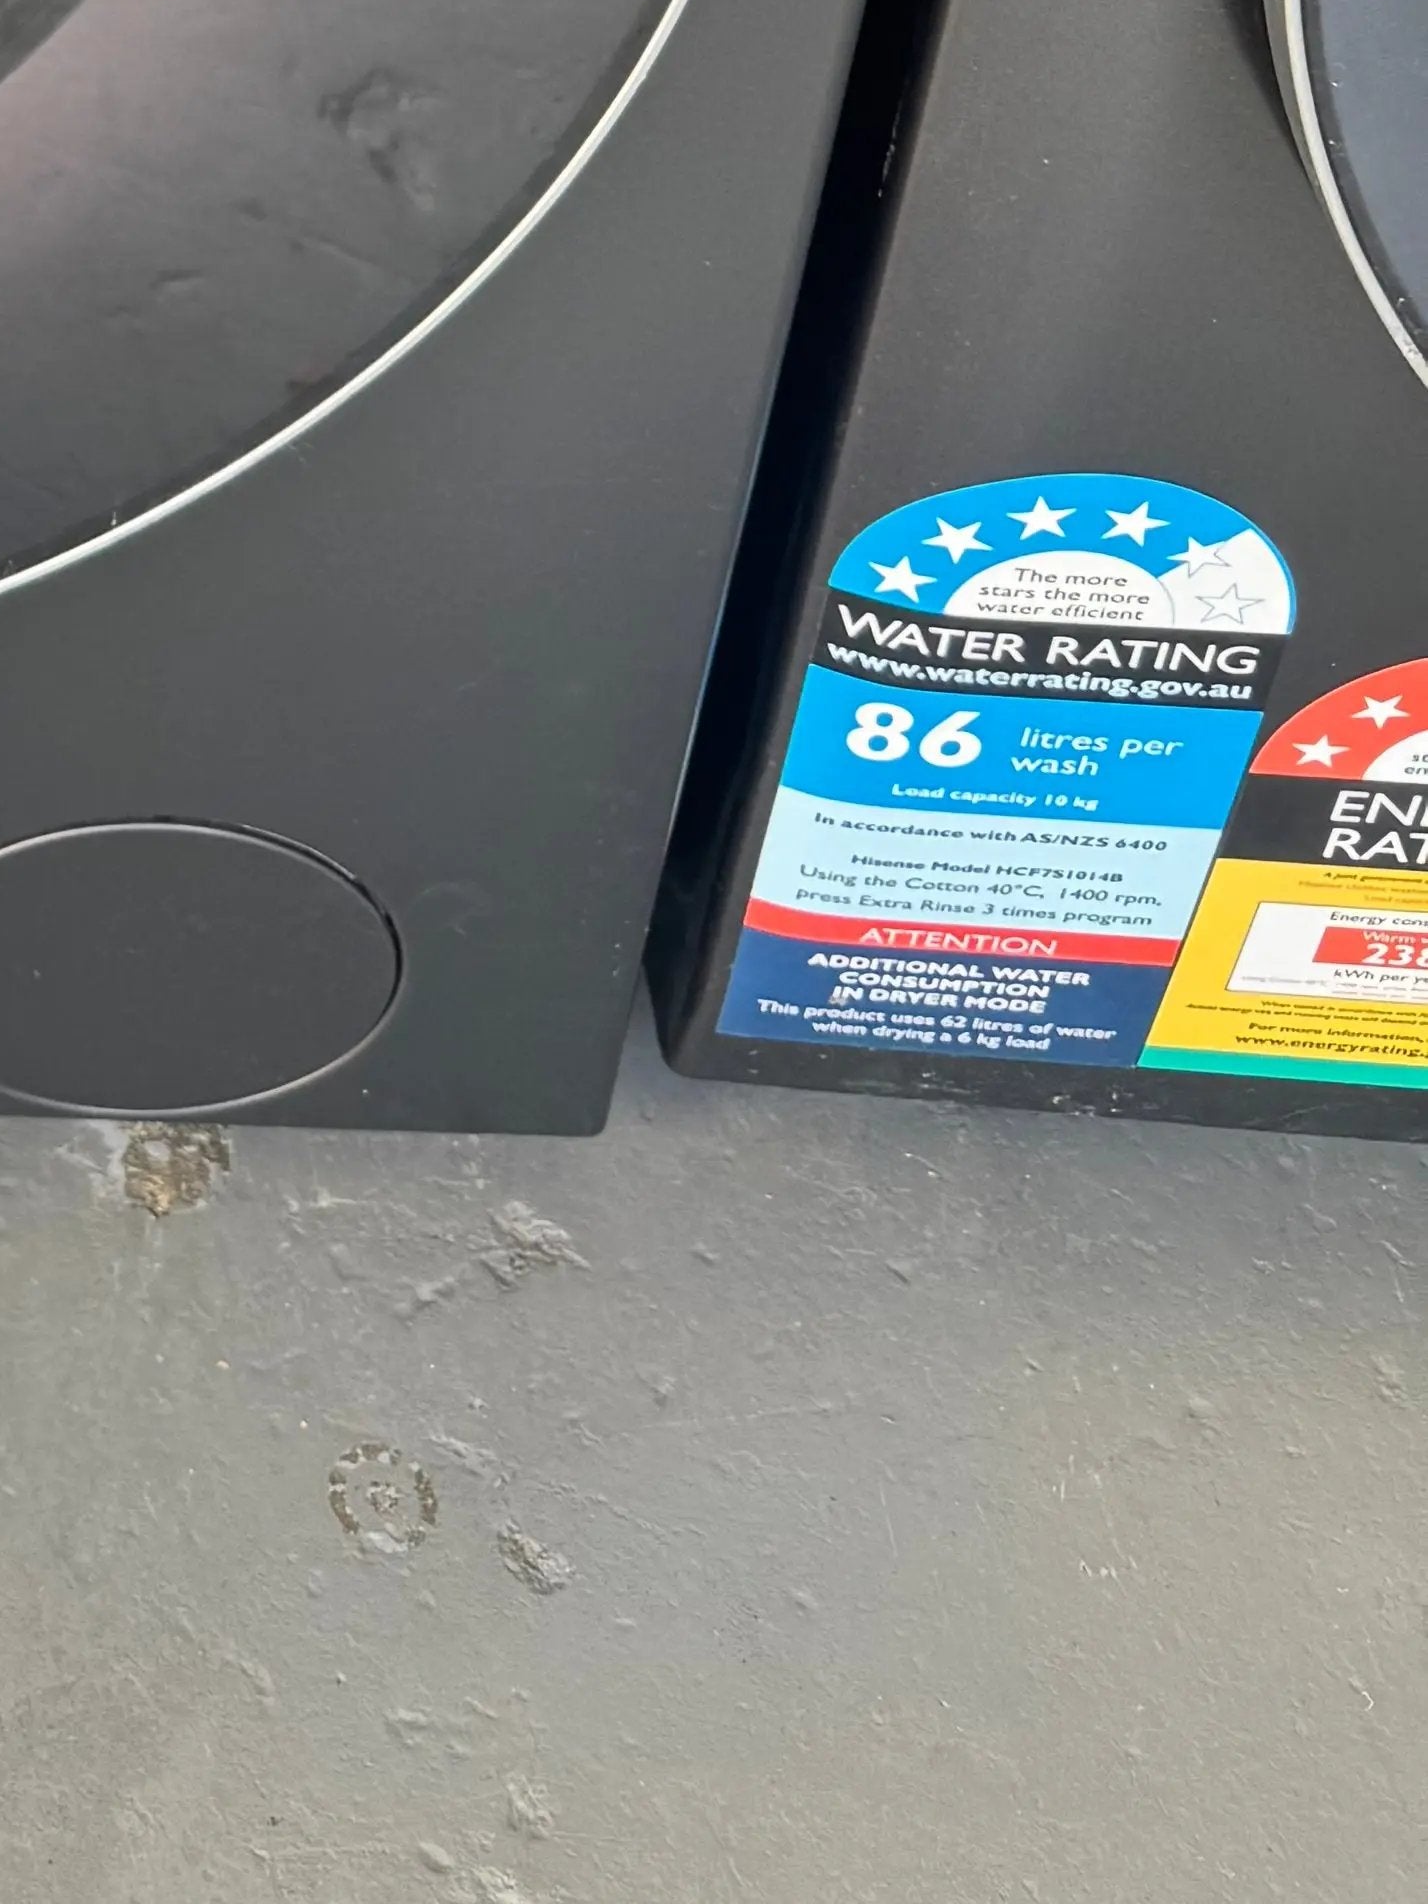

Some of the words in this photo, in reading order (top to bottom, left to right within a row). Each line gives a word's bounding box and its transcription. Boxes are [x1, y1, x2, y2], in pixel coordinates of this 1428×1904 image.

[1014, 567, 1058, 586] The
[1065, 573, 1128, 588] more
[976, 601, 1045, 617] water
[1051, 603, 1145, 623] efficient
[978, 584, 1035, 600] stars
[1043, 586, 1084, 602] the
[1088, 592, 1151, 606] more
[836, 602, 1026, 664] WATER
[1045, 634, 1261, 676] RATING
[825, 640, 1254, 701] www.waterrating.gov.au
[845, 701, 983, 769] 86
[1019, 727, 1110, 754] litres
[1119, 735, 1185, 761] per
[1010, 754, 1101, 778] wash
[891, 783, 945, 800] Load
[949, 788, 1037, 808] capacity
[1044, 792, 1068, 808] 10
[1072, 794, 1100, 812] kg
[1329, 789, 1428, 829] EN
[813, 811, 836, 826] In
[840, 817, 965, 840] accordance
[970, 827, 1018, 844] with
[1019, 830, 1110, 850] AS/NZS
[1114, 838, 1169, 853] 6400
[850, 853, 926, 871] Hisense
[930, 859, 991, 876] Model
[799, 863, 858, 889] Using
[863, 872, 898, 889] the
[904, 877, 980, 896] Cotton
[1060, 886, 1109, 903] 1400
[795, 887, 852, 908] press
[858, 893, 913, 912] Extra
[919, 898, 976, 916] Rinse
[982, 902, 995, 917] 3
[1001, 906, 1057, 922] times
[1061, 910, 1154, 929] program
[858, 926, 1059, 957] ATTENTION
[806, 952, 985, 980] ADDITIONAL
[990, 965, 1092, 987] WATER
[838, 970, 1051, 999] CONSUMPTION
[832, 984, 864, 1004] IN
[868, 988, 959, 1009] DRYER
[963, 994, 1048, 1015] MODE
[756, 997, 800, 1017] This
[802, 1002, 887, 1024] product
[890, 1011, 936, 1026] uses
[939, 1014, 967, 1030] 62
[971, 1015, 1025, 1034] litres
[1028, 1021, 1056, 1036] of
[1057, 1024, 1118, 1041] water
[811, 1018, 869, 1038] when
[871, 1024, 937, 1045] drying
[938, 1030, 954, 1043] a
[956, 1030, 972, 1044] 6
[975, 1031, 1002, 1050] kg
[1004, 1033, 1051, 1052] load
